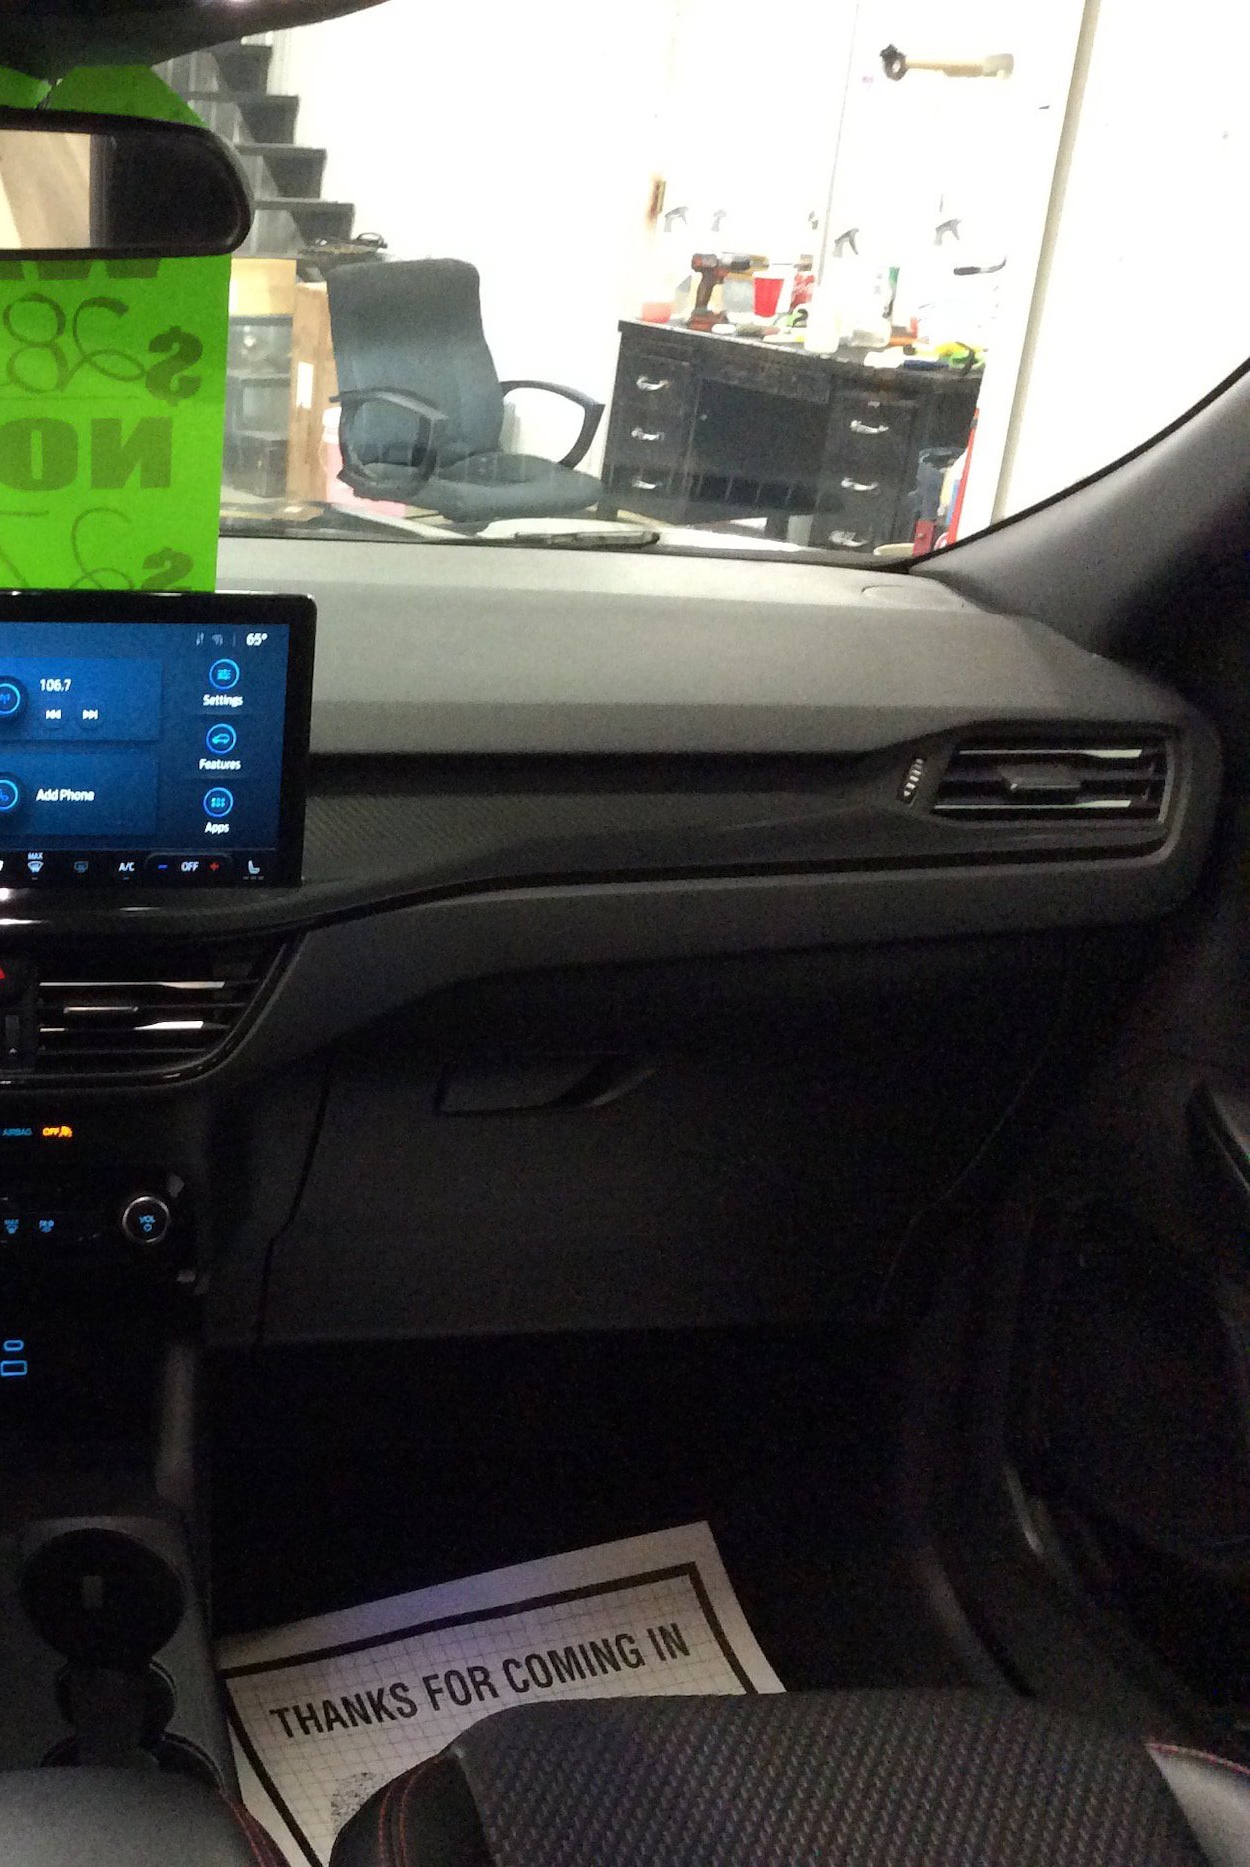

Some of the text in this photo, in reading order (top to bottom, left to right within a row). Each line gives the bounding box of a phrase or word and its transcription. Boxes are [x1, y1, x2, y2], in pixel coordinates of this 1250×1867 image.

[39, 678, 72, 693] 106.7
[202, 694, 244, 709] Settings
[199, 759, 242, 771] Features
[36, 788, 95, 802] Add Phone
[204, 822, 230, 836] Apps
[27, 853, 44, 861] MAX
[118, 861, 135, 873] A/C
[180, 861, 199, 873] OFF
[2, 1127, 32, 1136] AIRBAG
[42, 1127, 59, 1137] OFF
[269, 1622, 692, 1740] THANKS FOR COMING IN
